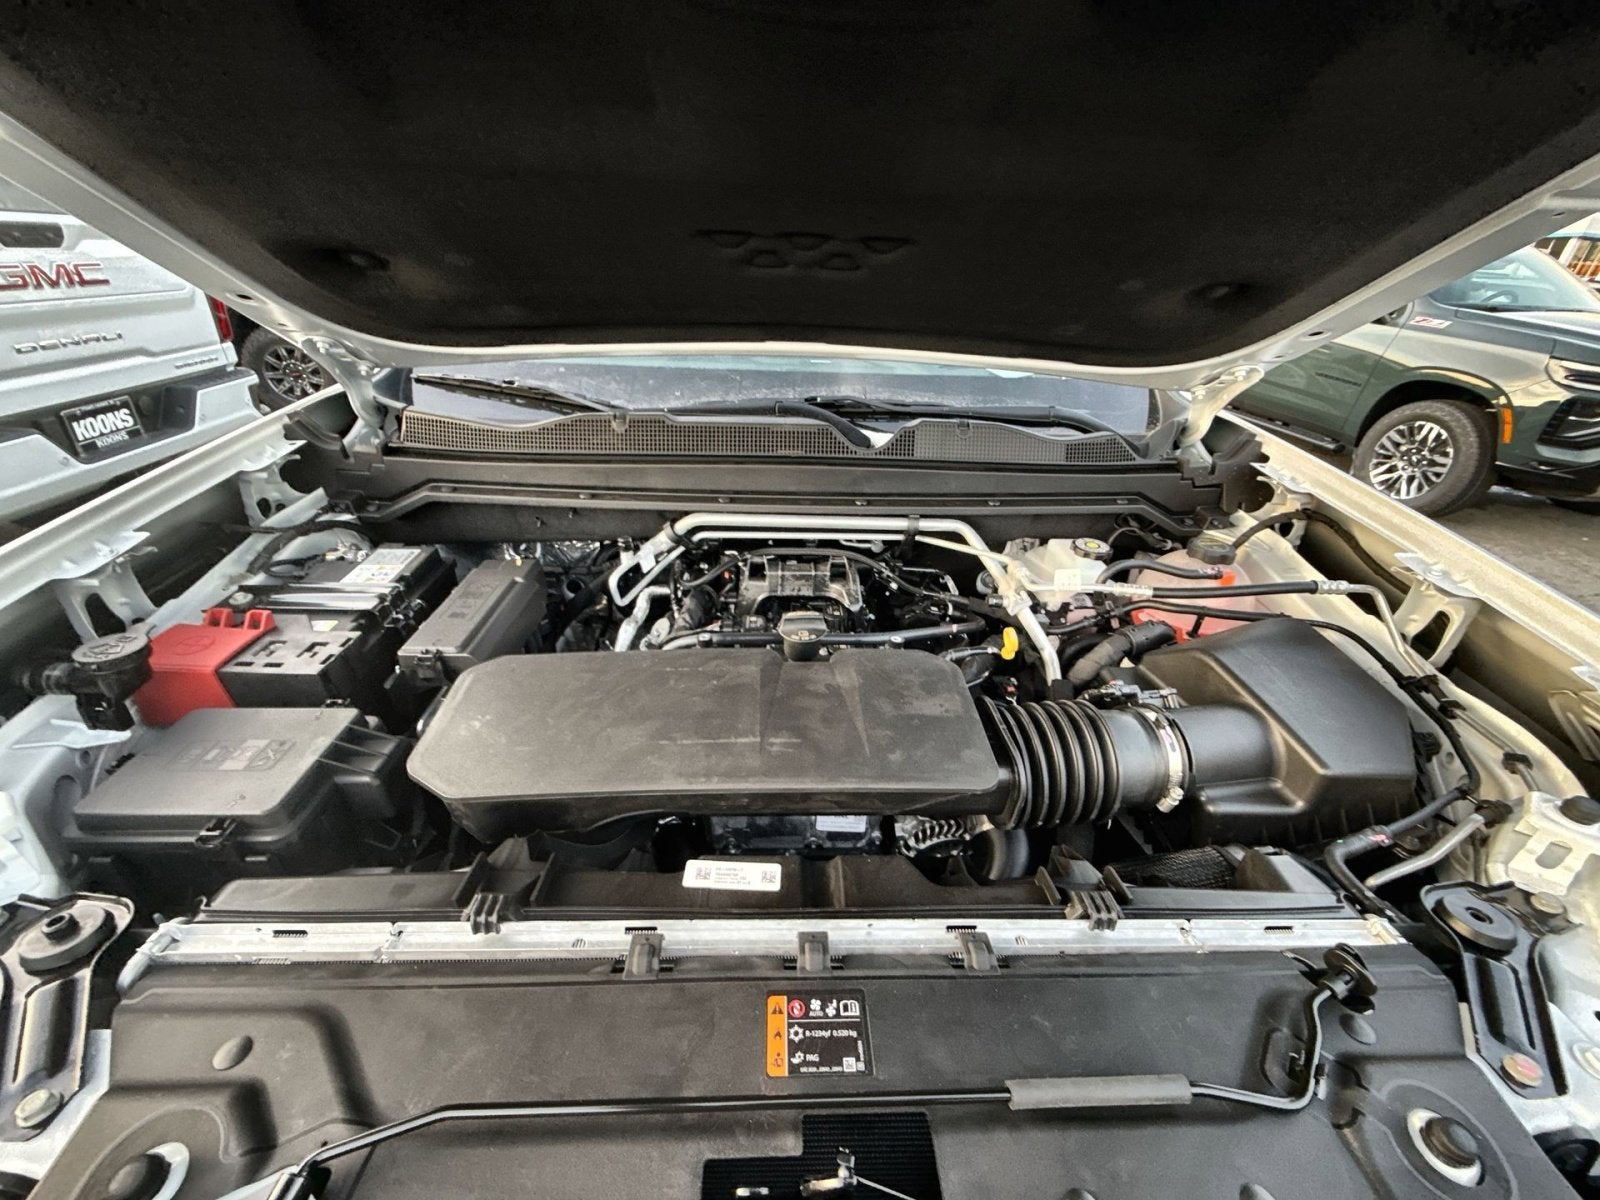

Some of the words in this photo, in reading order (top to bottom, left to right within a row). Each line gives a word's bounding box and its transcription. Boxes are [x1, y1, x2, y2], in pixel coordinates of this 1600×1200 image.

[0, 262, 111, 291] GMC
[13, 332, 123, 354] DENALI
[71, 408, 134, 441] KOONS
[805, 1029, 831, 1038] R-1234yf
[805, 1053, 820, 1062] PAG
